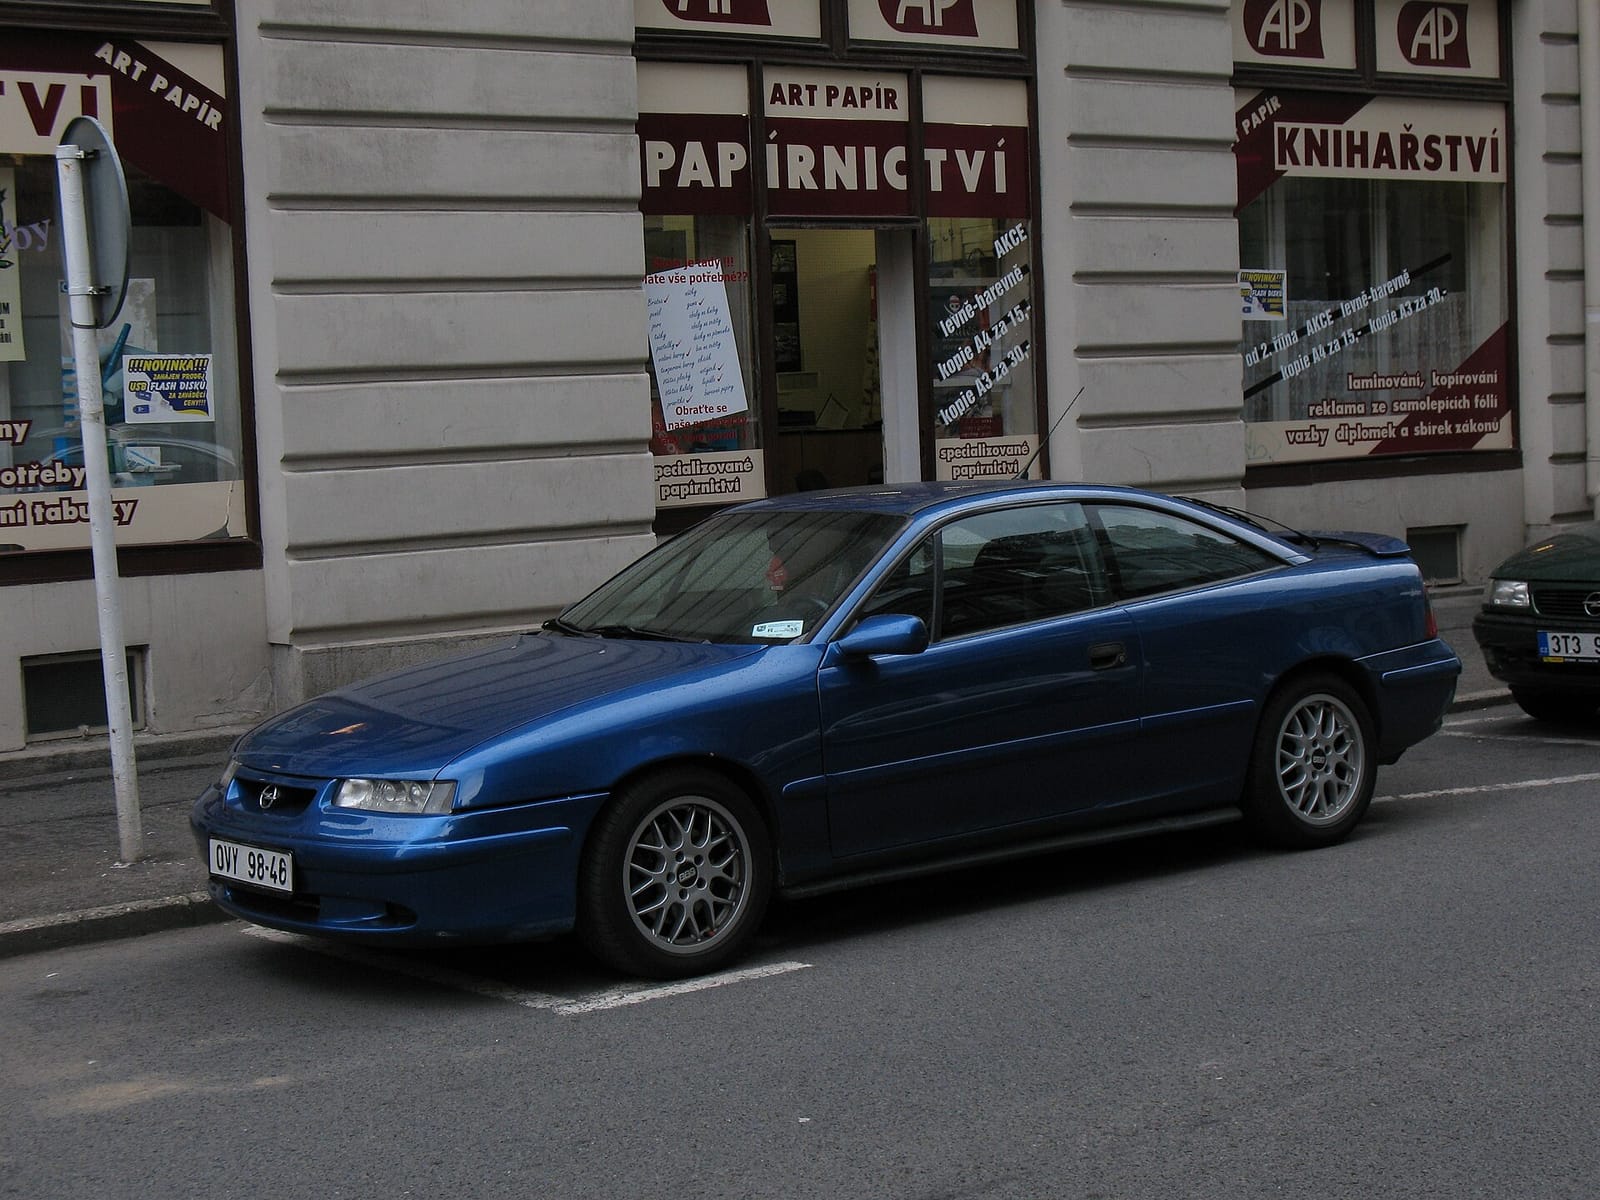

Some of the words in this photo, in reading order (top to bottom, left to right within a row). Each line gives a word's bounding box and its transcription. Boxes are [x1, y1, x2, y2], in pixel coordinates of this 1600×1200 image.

[1257, 0, 1312, 50] AP
[1409, 7, 1459, 60] AP
[95, 41, 149, 82] ART
[149, 73, 223, 132] PAPÍR
[770, 82, 818, 107] ART
[826, 82, 898, 110] PAPÍR
[1240, 95, 1282, 136] PAPÍR
[1277, 123, 1500, 174] KNIHAŘSTVÍ
[993, 222, 1028, 260] AKCE
[668, 271, 686, 285] vše
[939, 263, 1024, 338] levně-barevně
[1245, 346, 1260, 367] od
[1260, 342, 1272, 360] 2.
[1305, 308, 1334, 337] AKCE
[1340, 267, 1412, 319] levně-barevně
[937, 346, 975, 381] kopie
[973, 330, 993, 355] A4
[991, 319, 1009, 341] za
[1280, 351, 1311, 381] kopie
[1312, 346, 1327, 364] A4
[1326, 338, 1341, 355] za
[1368, 311, 1398, 335] kopie
[1399, 300, 1414, 321] A3
[1414, 296, 1428, 313] za
[128, 359, 208, 372] !!!NOVINKA!!!
[1347, 371, 1425, 392] laminování,
[1431, 369, 1499, 390] kopírování
[150, 381, 177, 391] FLASH
[939, 389, 977, 426] kopie
[974, 371, 994, 398] A3
[992, 361, 1010, 383] za
[716, 405, 728, 413] se
[1308, 400, 1365, 418] reklama
[1371, 403, 1388, 415] ze
[1287, 425, 1329, 447] vazby
[1335, 421, 1397, 446] diplomek
[1400, 428, 1410, 438] a
[1413, 419, 1453, 437] sbírek
[939, 441, 1030, 463] specializované
[952, 459, 1019, 481] papírnictví
[660, 477, 740, 501] papírnictví
[1551, 635, 1582, 654] 3T3
[216, 844, 239, 876] OVY
[248, 851, 287, 886] 98-46
